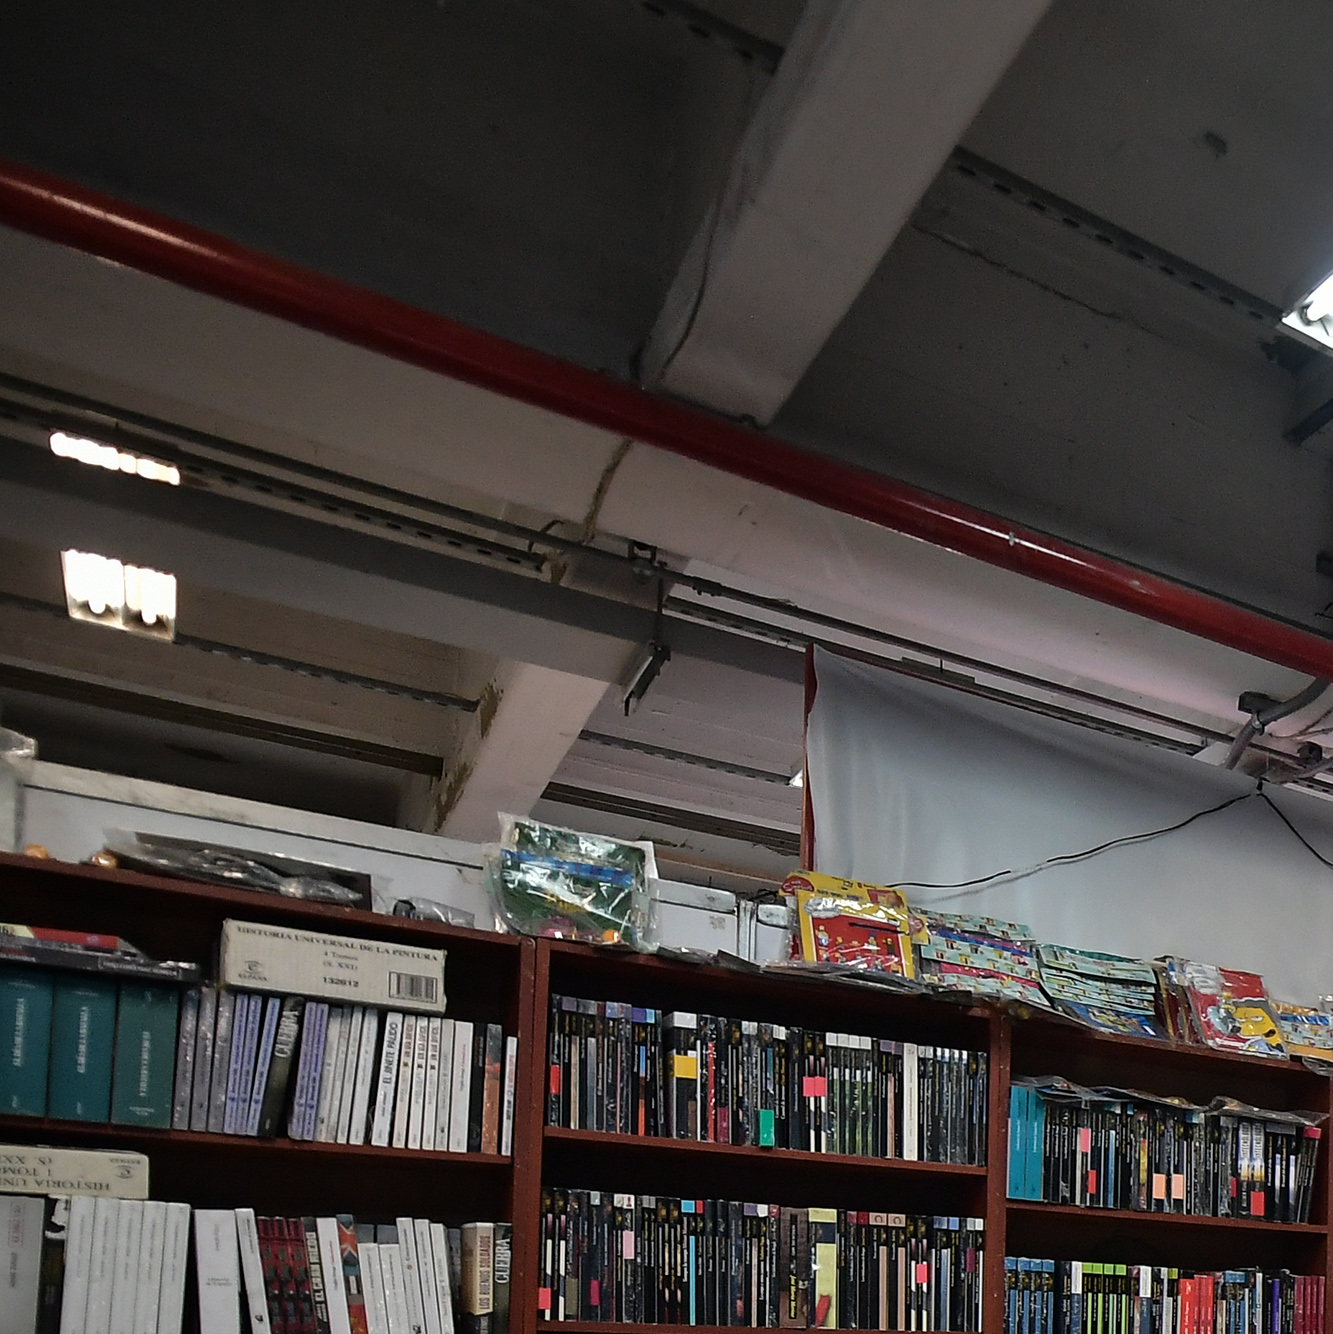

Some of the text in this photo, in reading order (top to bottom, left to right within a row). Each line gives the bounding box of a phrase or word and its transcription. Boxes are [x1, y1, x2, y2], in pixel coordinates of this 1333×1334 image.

[295, 934, 355, 950] UNIVERSAL
[359, 943, 374, 952] DE
[376, 946, 390, 955] LA
[392, 950, 438, 962] PINTURA
[34, 1178, 110, 1191] HISTORIA
